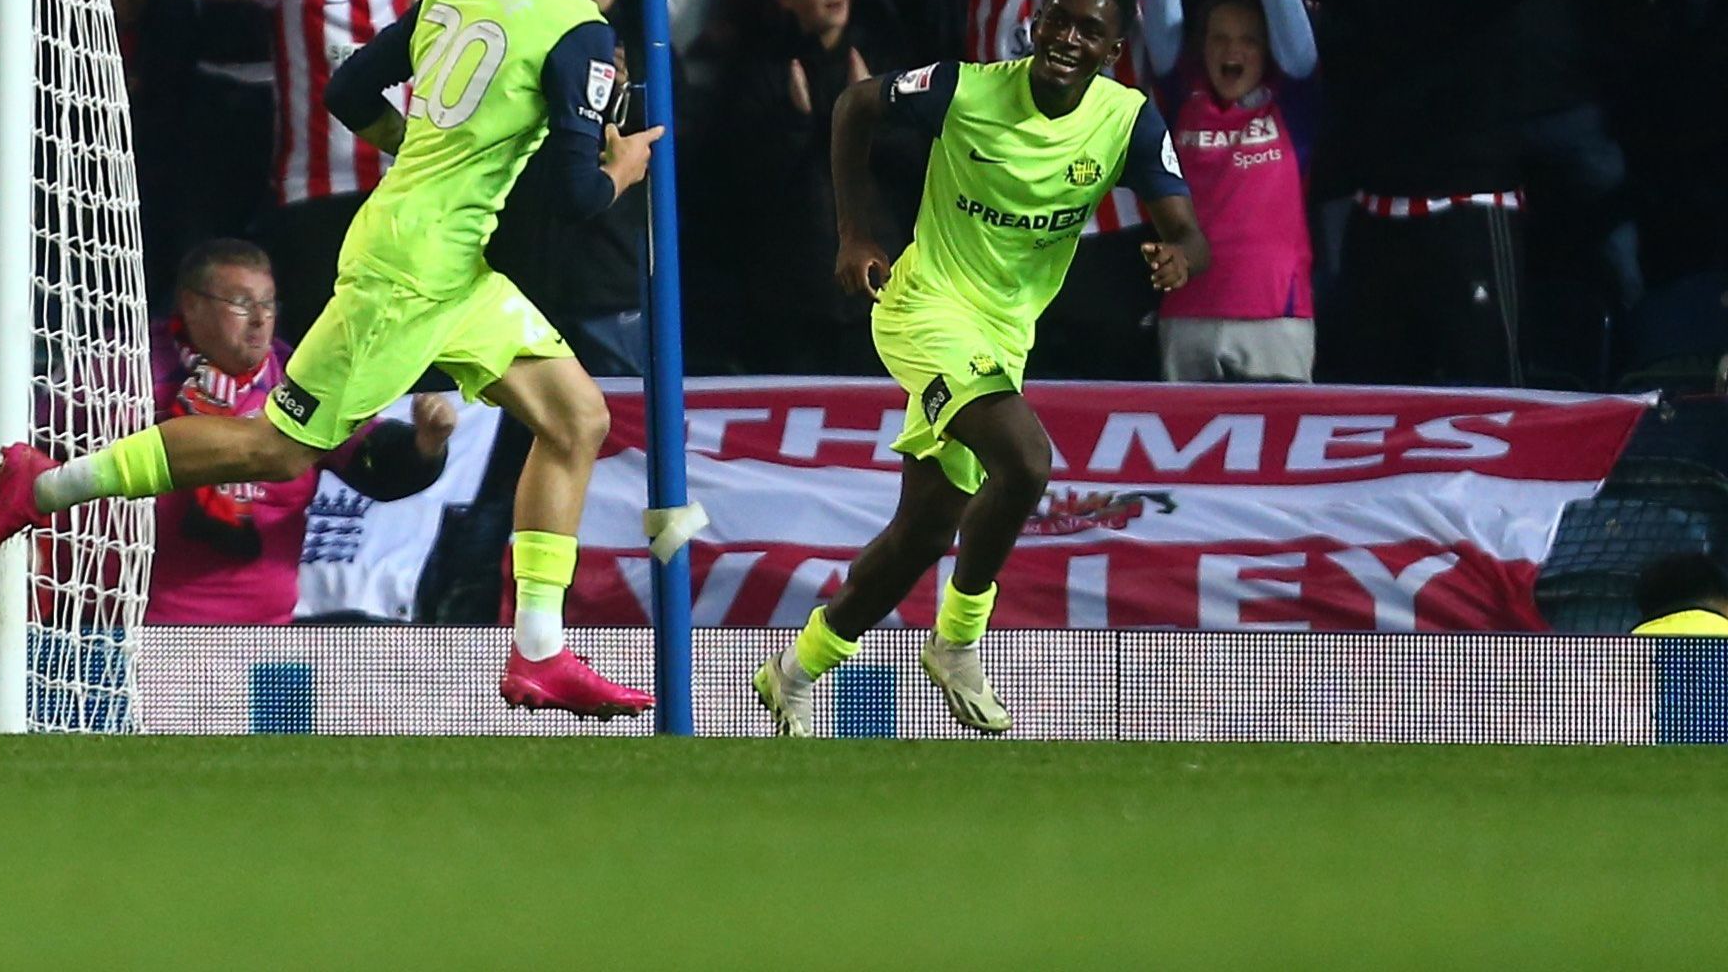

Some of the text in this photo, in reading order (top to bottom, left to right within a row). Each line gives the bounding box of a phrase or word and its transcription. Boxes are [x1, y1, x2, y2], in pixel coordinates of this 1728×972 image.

[406, 2, 507, 129] 20
[1232, 147, 1282, 169] Sports
[956, 193, 1090, 232] SPREADEX
[276, 388, 305, 417] dea
[615, 547, 1460, 631] VALEY
